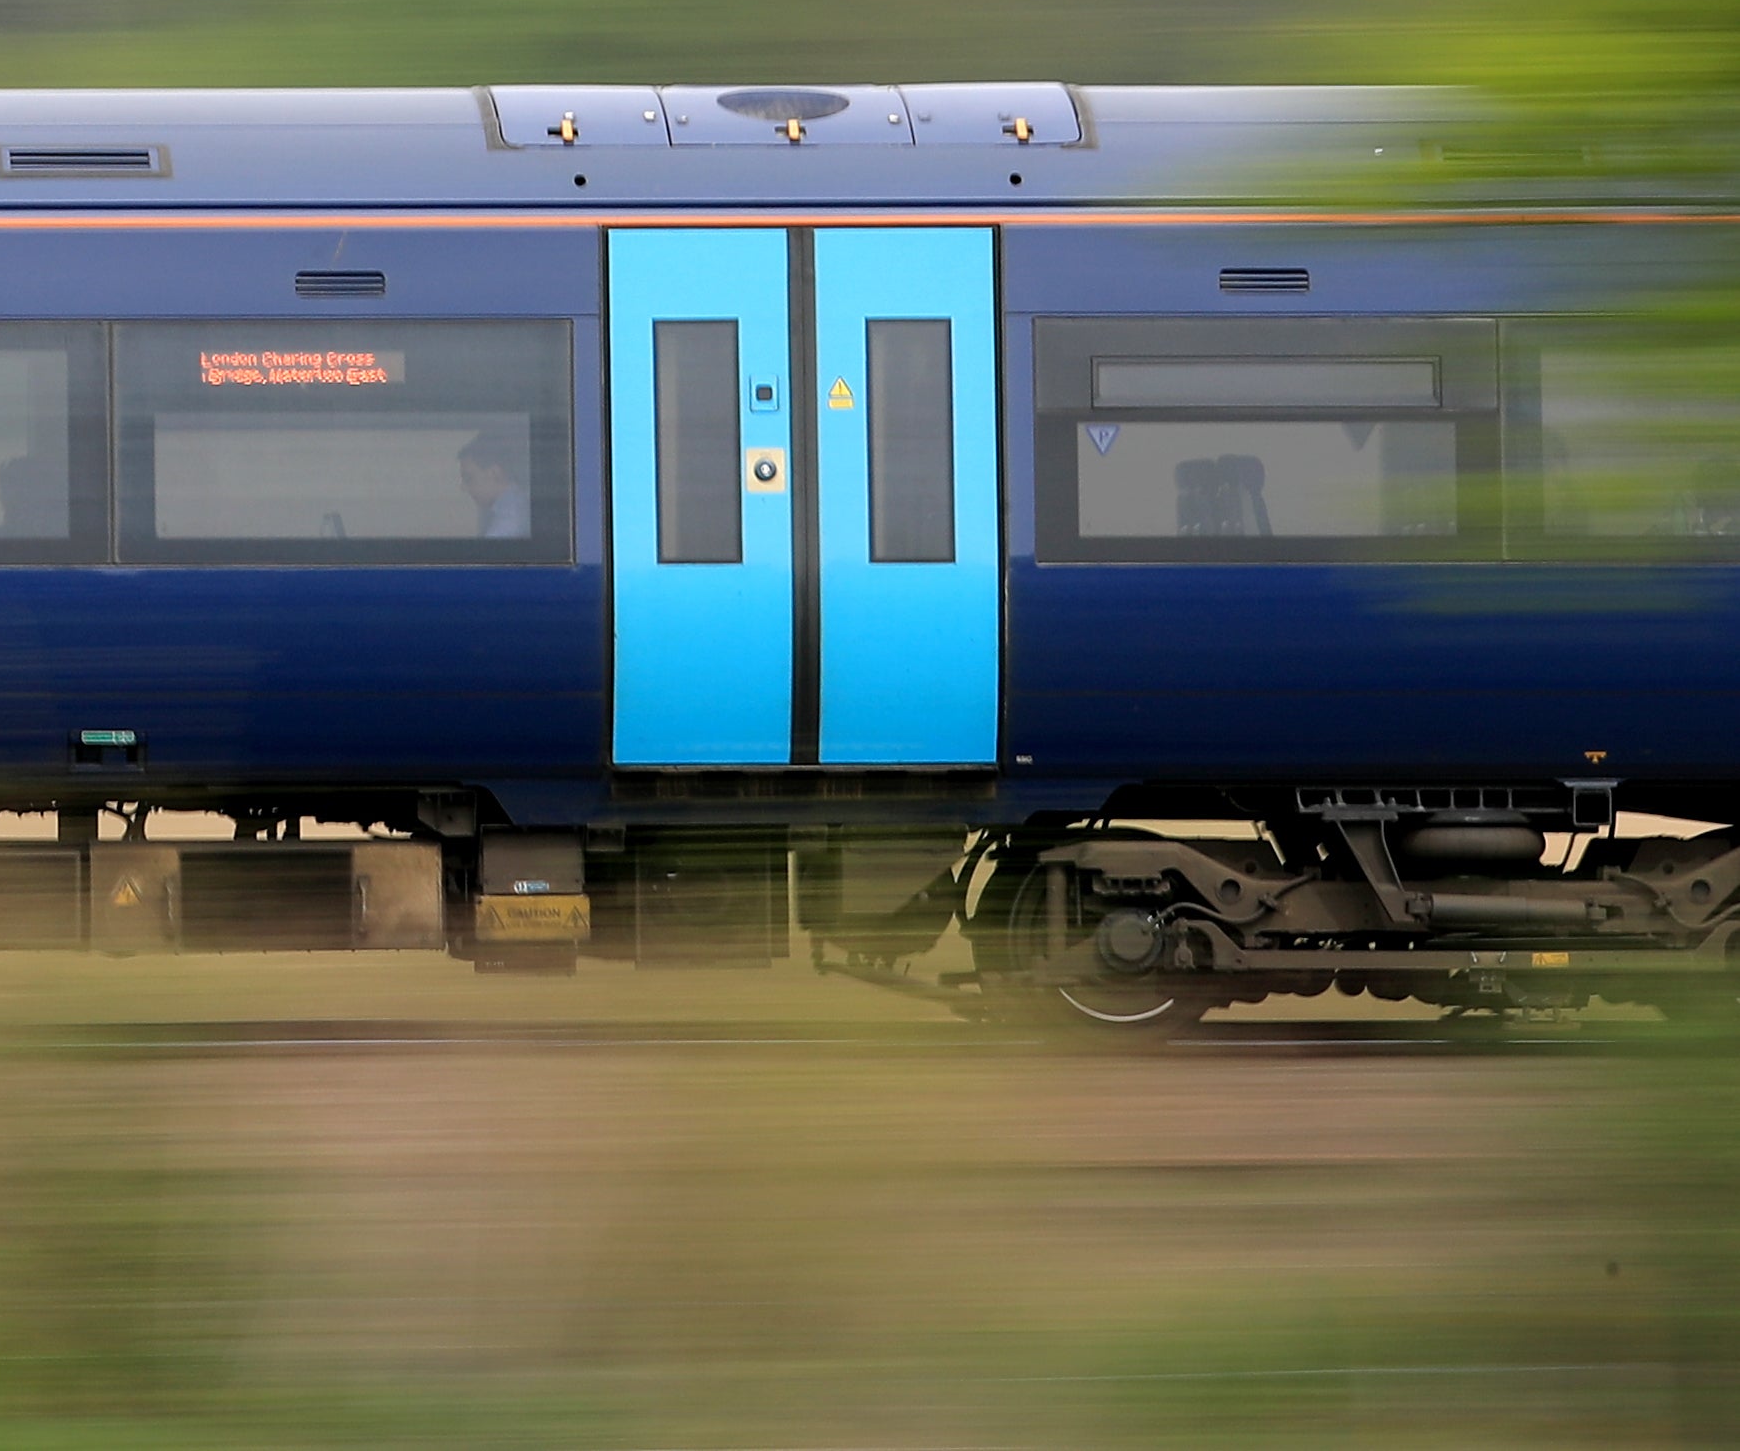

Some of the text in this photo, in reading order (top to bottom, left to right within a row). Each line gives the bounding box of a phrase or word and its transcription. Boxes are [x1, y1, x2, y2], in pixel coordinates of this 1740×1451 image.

[200, 351, 375, 368] London Charing Cross
